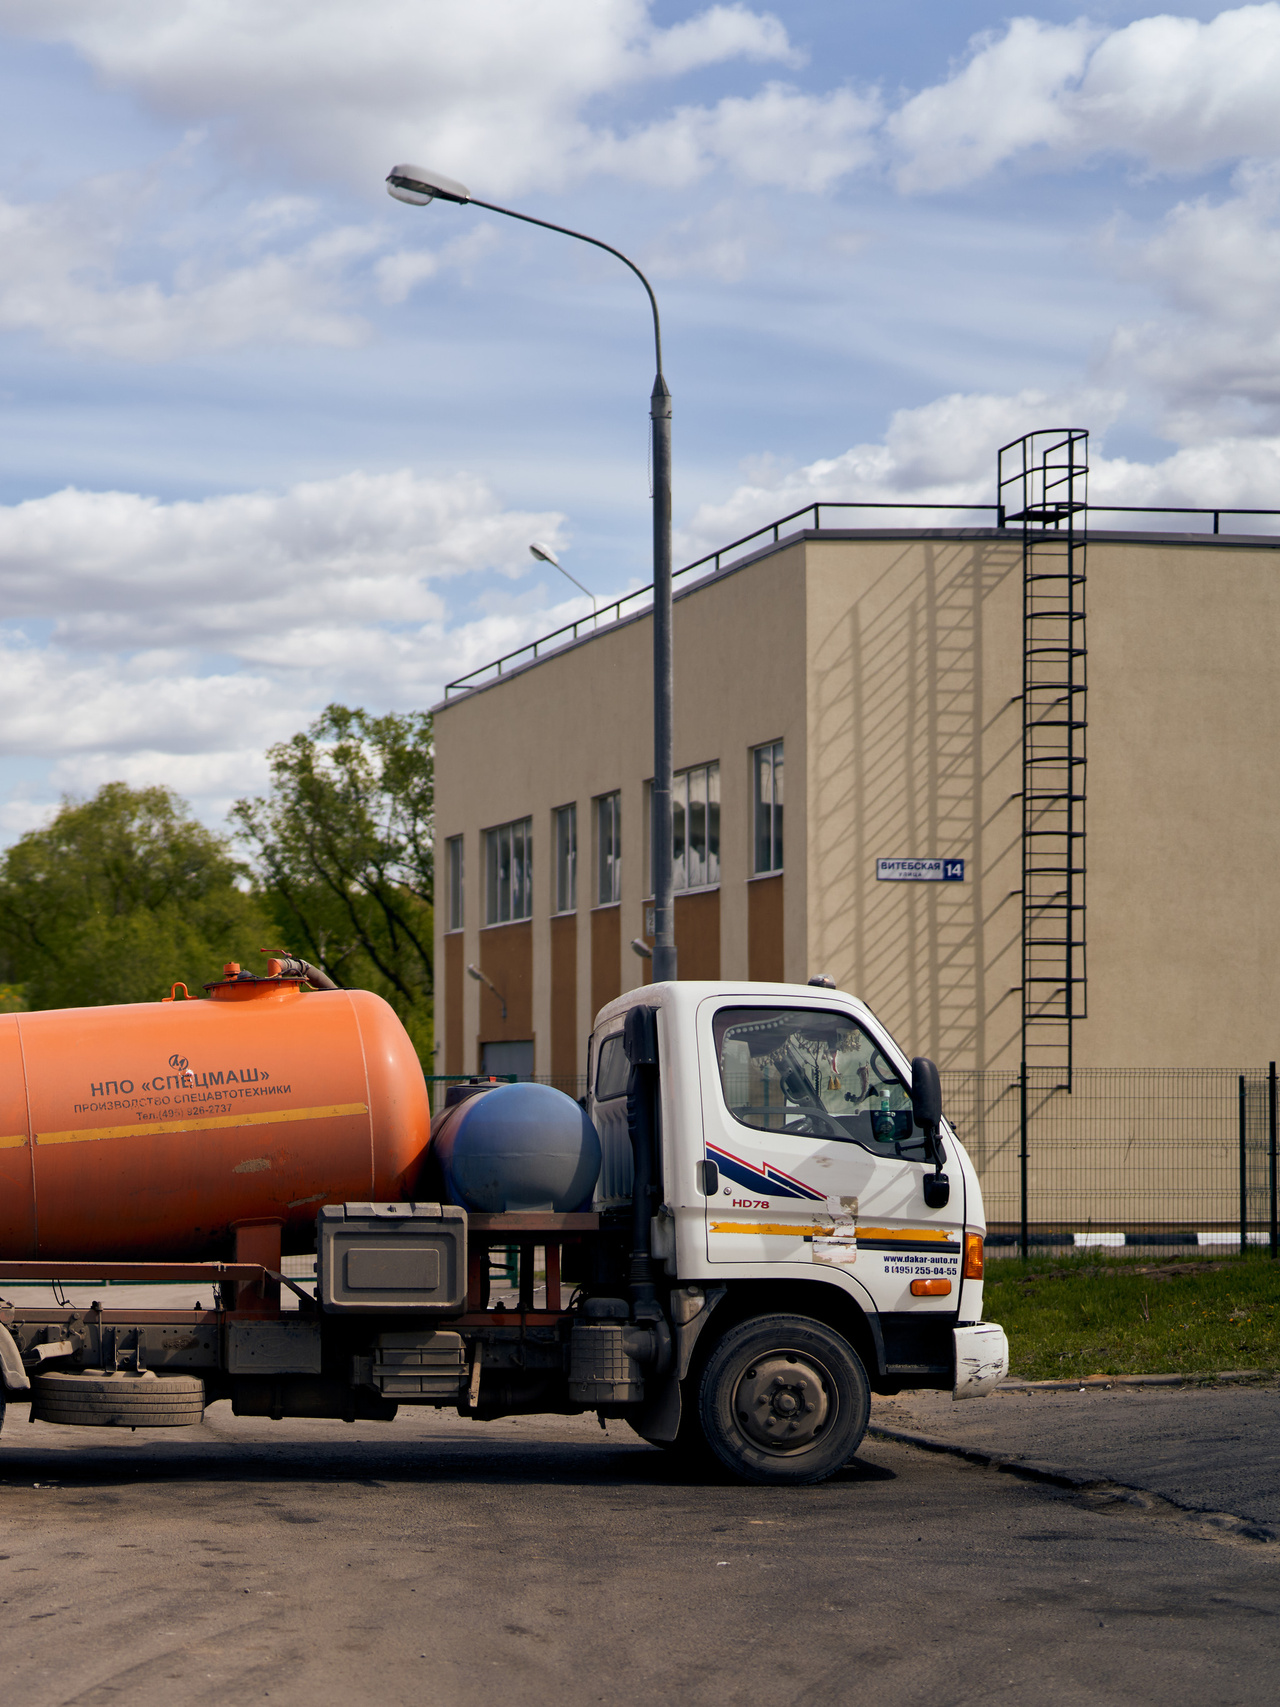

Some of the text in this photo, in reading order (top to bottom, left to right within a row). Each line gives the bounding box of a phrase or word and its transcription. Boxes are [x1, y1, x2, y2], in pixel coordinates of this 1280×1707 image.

[881, 862, 941, 870] ВИТЕБСКАЯ
[945, 863, 962, 877] 14
[90, 1068, 270, 1097] НПО «СПЕЦМАШ»
[74, 1085, 292, 1114] ПРОИЗВОДСТВО СПЕЦАВТОТЕХНИКИ
[732, 1199, 770, 1209] HD78
[883, 1255, 958, 1264] www.dakar-auto.ru
[884, 1265, 957, 1275] 8 (495) 255-04-55
